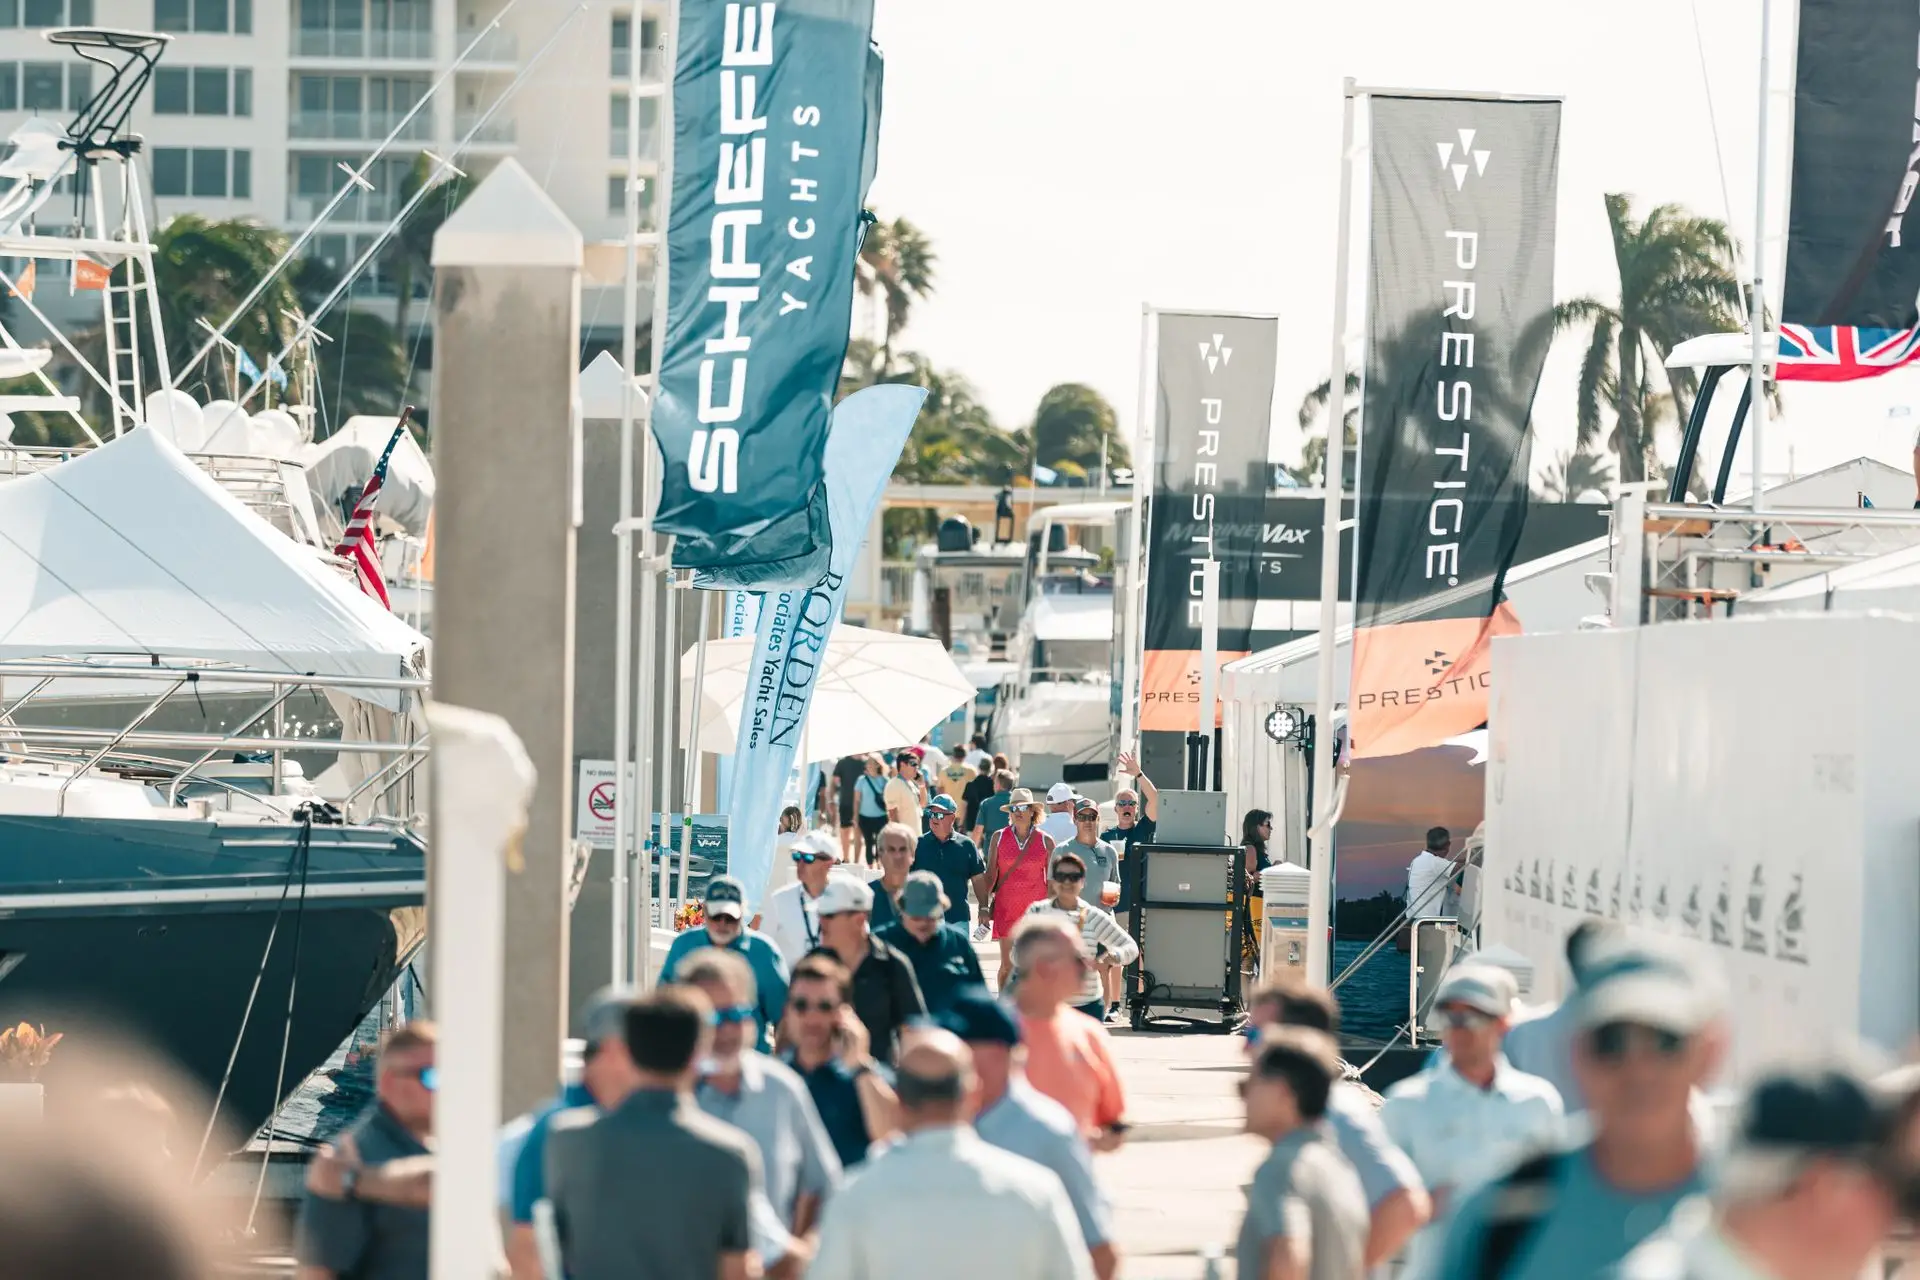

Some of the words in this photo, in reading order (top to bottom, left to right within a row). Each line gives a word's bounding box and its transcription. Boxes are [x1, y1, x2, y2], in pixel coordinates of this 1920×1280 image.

[779, 104, 820, 316] YACHTS
[1426, 230, 1478, 579] PRESTIGE
[768, 590, 792, 652] ociates
[756, 657, 781, 704] Yacht
[769, 570, 843, 749] BORDEN
[1145, 691, 1201, 704] PRES
[1358, 671, 1491, 710] PRESTI
[749, 706, 768, 750] Sales
